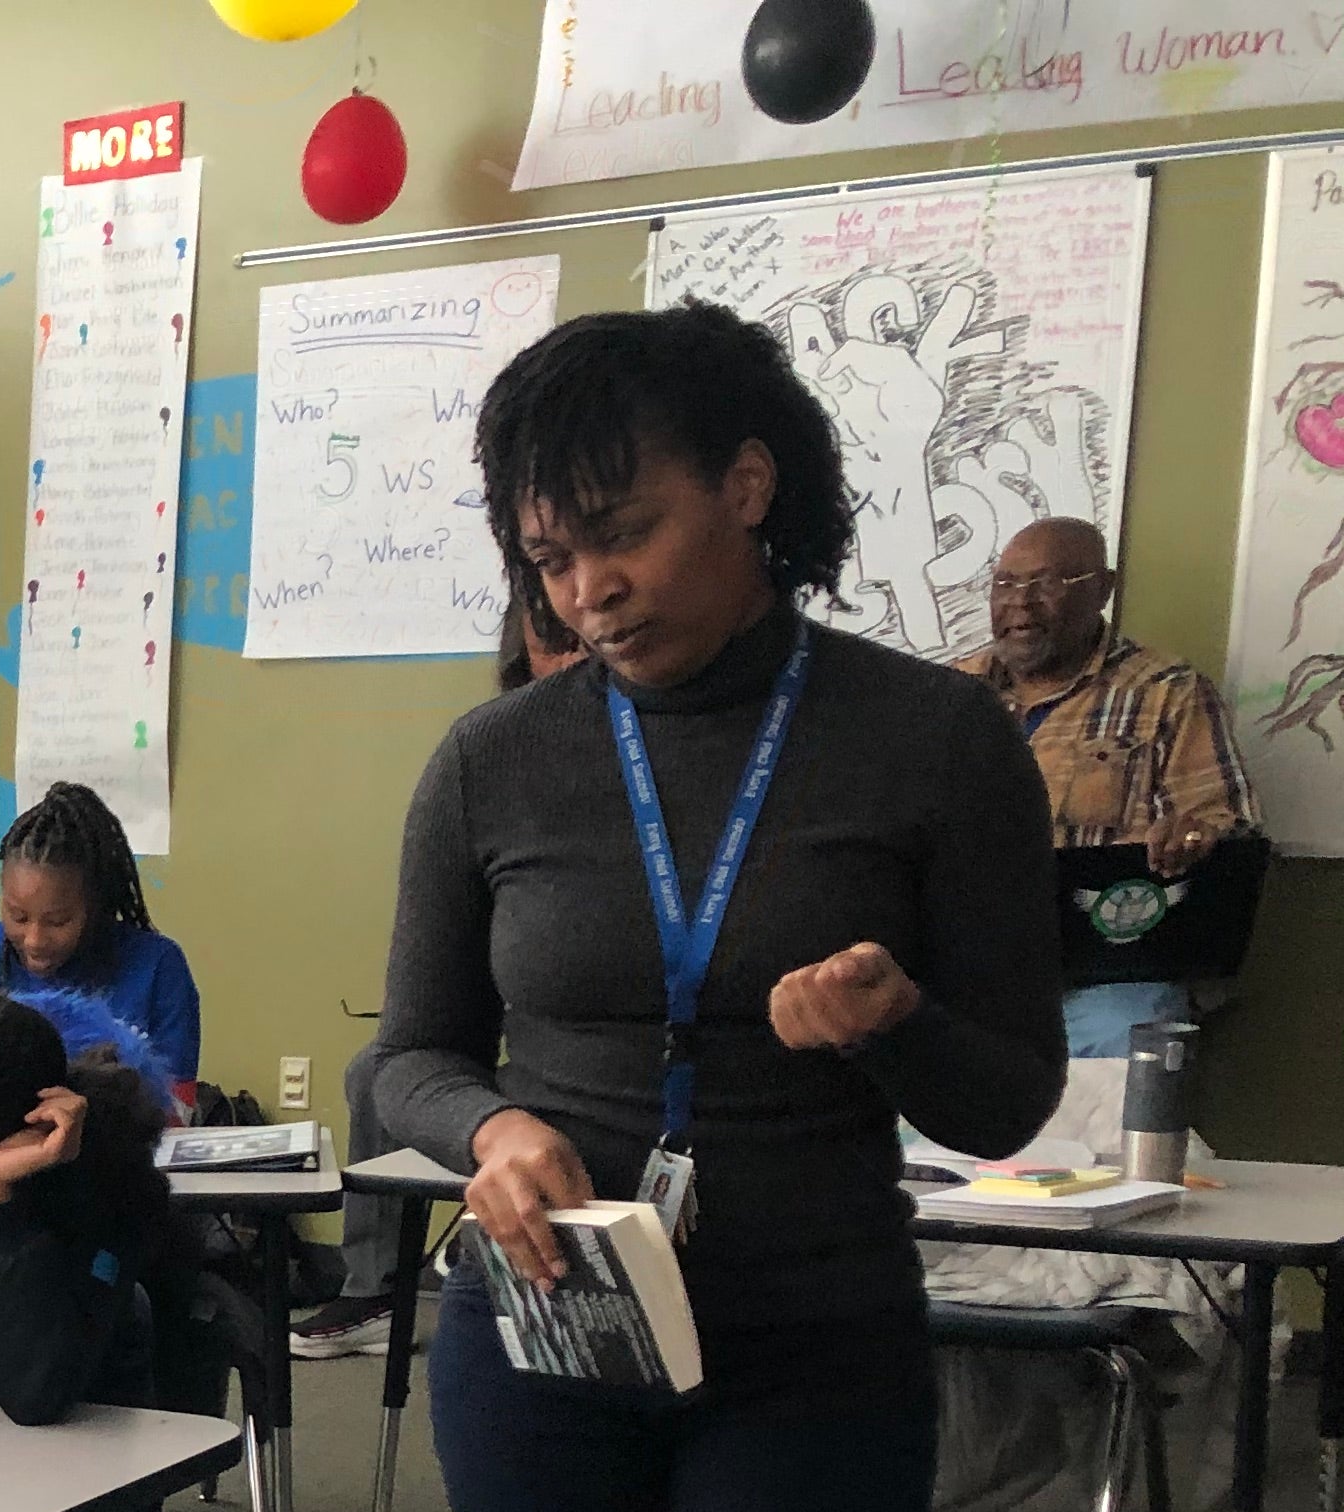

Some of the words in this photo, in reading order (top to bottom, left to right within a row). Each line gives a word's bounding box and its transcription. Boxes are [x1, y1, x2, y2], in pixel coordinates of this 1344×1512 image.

[70, 115, 173, 172] MORE
[290, 294, 481, 337] Summarizing
[272, 388, 340, 424] Who?
[316, 432, 360, 502] 5
[364, 527, 451, 565] Where?
